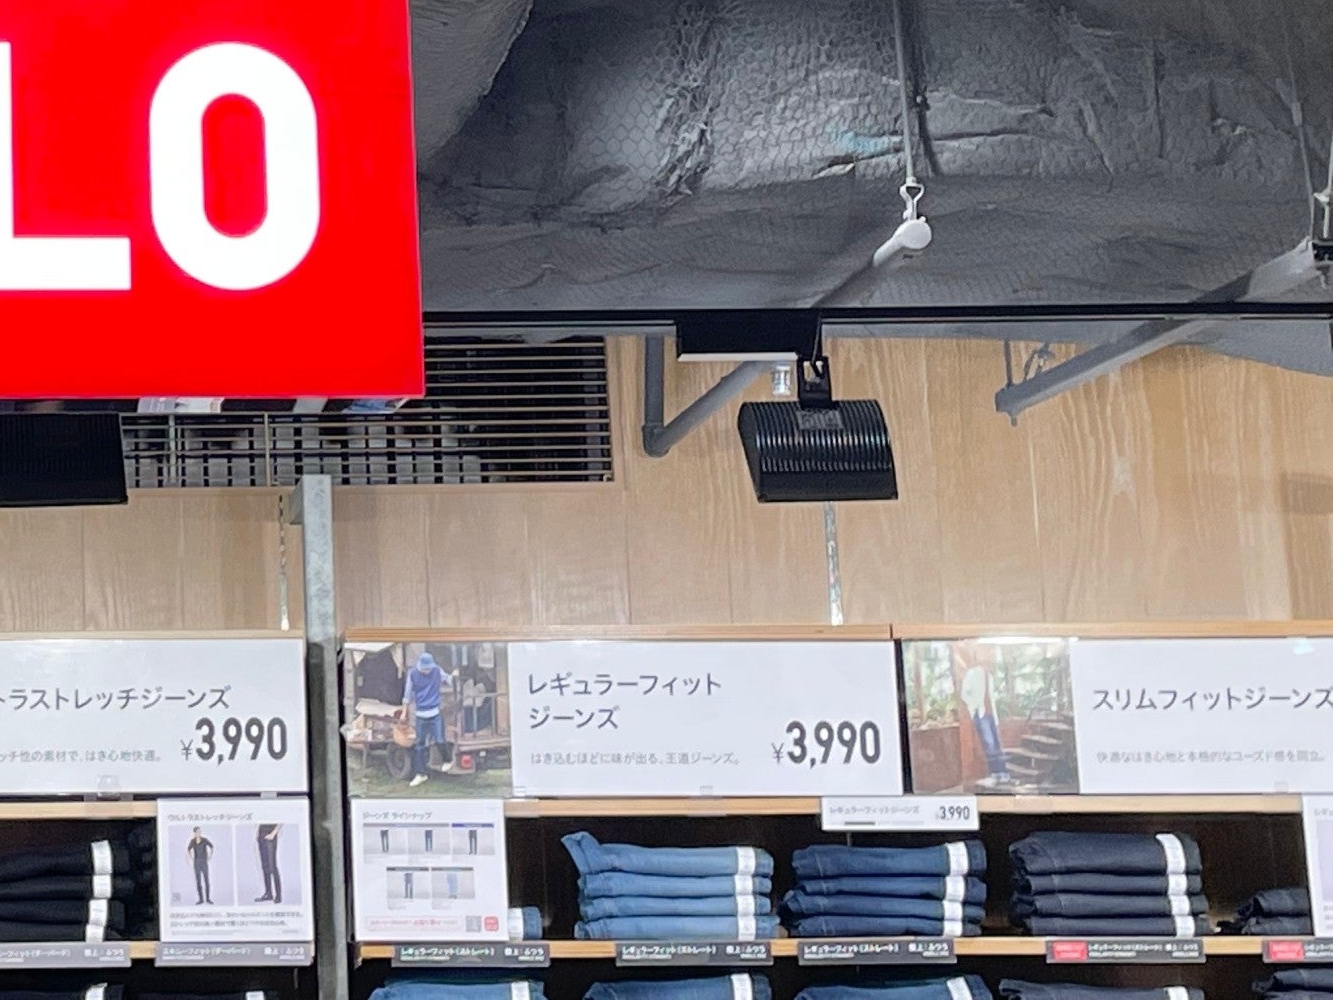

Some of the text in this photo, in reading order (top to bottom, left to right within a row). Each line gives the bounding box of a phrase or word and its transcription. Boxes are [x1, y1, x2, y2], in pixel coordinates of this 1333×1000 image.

[527, 672, 722, 697] レギュラーフィット
[529, 705, 621, 730] ジーンズ
[180, 716, 288, 766] ¥3,990
[772, 720, 881, 768] ¥3,990
